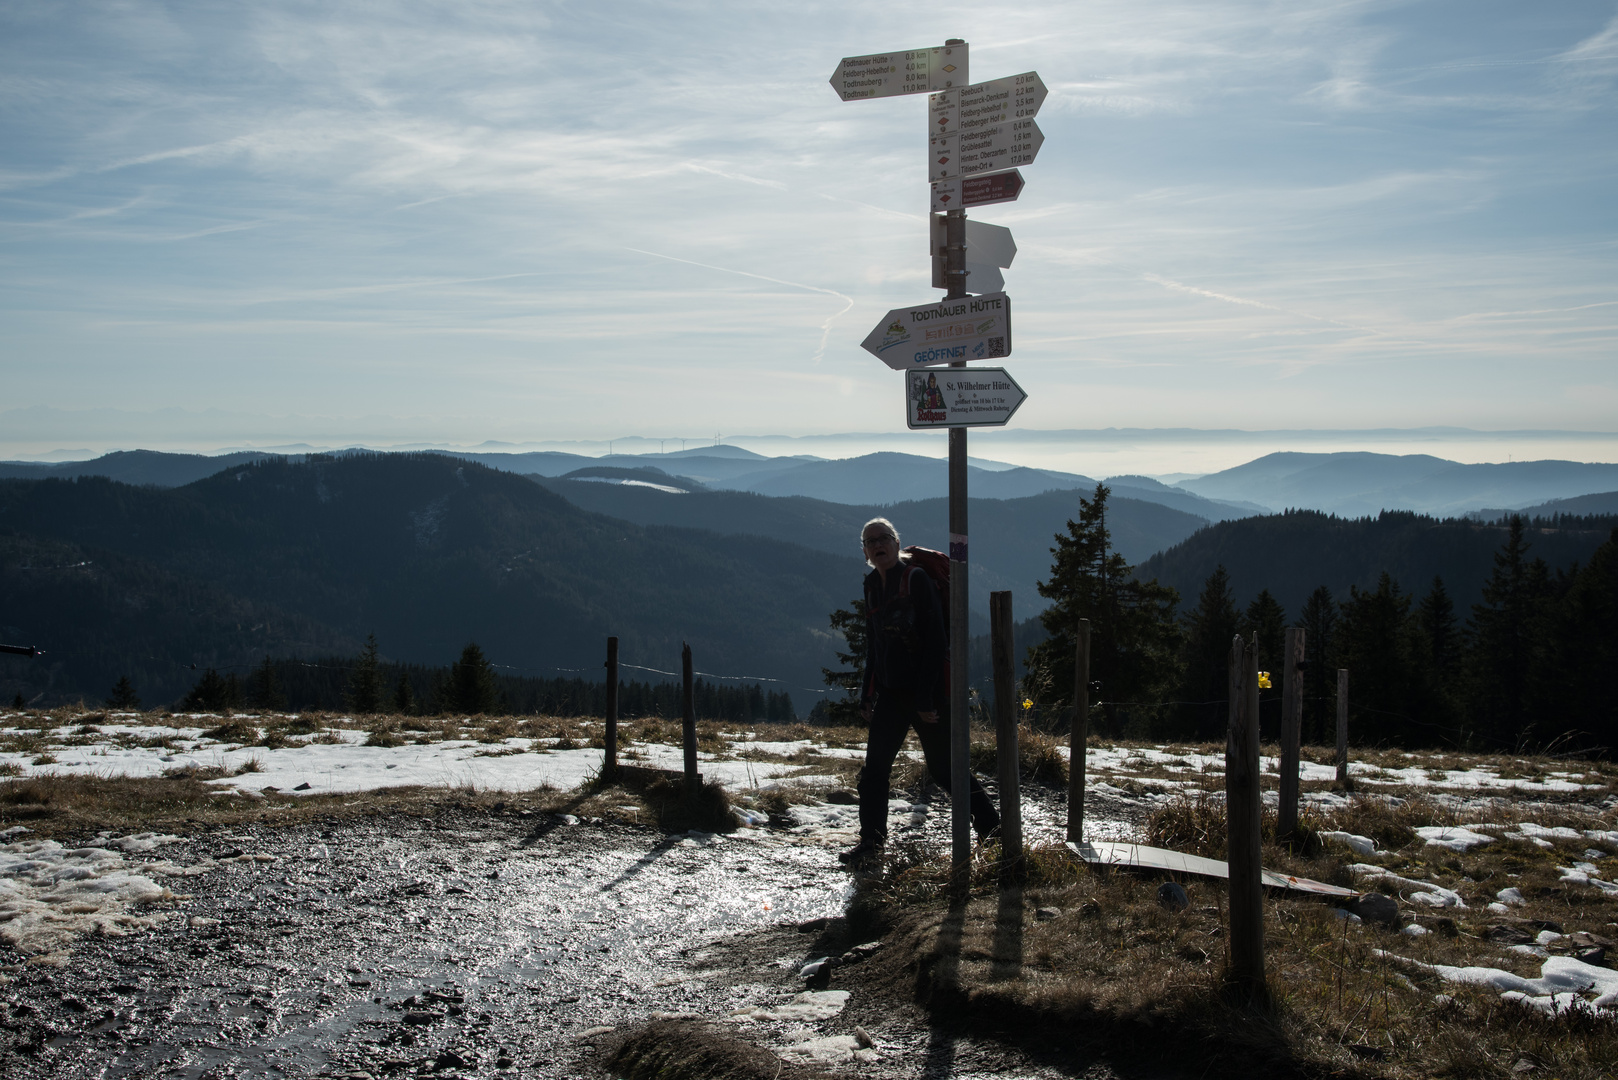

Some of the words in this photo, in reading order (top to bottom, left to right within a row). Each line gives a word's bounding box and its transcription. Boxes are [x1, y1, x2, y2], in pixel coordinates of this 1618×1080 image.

[842, 58, 872, 68] Todtnauer
[872, 56, 888, 64] Hütte
[843, 66, 889, 78] Feldberg-Hebelhof
[843, 78, 882, 88] Todtnauberg
[961, 86, 984, 97] Seebuck
[1016, 77, 1024, 85] 2,0
[843, 89, 868, 98] Todtnau
[961, 91, 1009, 108] Bismarck-Denkmal
[961, 103, 1002, 118] Feldberg-Hebelhof
[1016, 100, 1024, 108] 3,5
[961, 118, 990, 128] Feldberger
[1016, 110, 1024, 118] 4,0
[961, 127, 998, 142] Feldberggipfel
[961, 140, 992, 152] Grüblesattel
[980, 148, 1007, 158] Oberzarten
[1010, 144, 1022, 153] 13,0
[961, 162, 988, 173] Titisee-Ort
[910, 305, 966, 322] TODTNAUER
[970, 299, 1002, 313] HÜTTE
[914, 346, 967, 363] GEÖFFNET
[946, 382, 956, 391] St.
[957, 381, 991, 391] Wilhelmer
[992, 381, 1010, 390] Hütte
[917, 408, 946, 423] Rothaus
